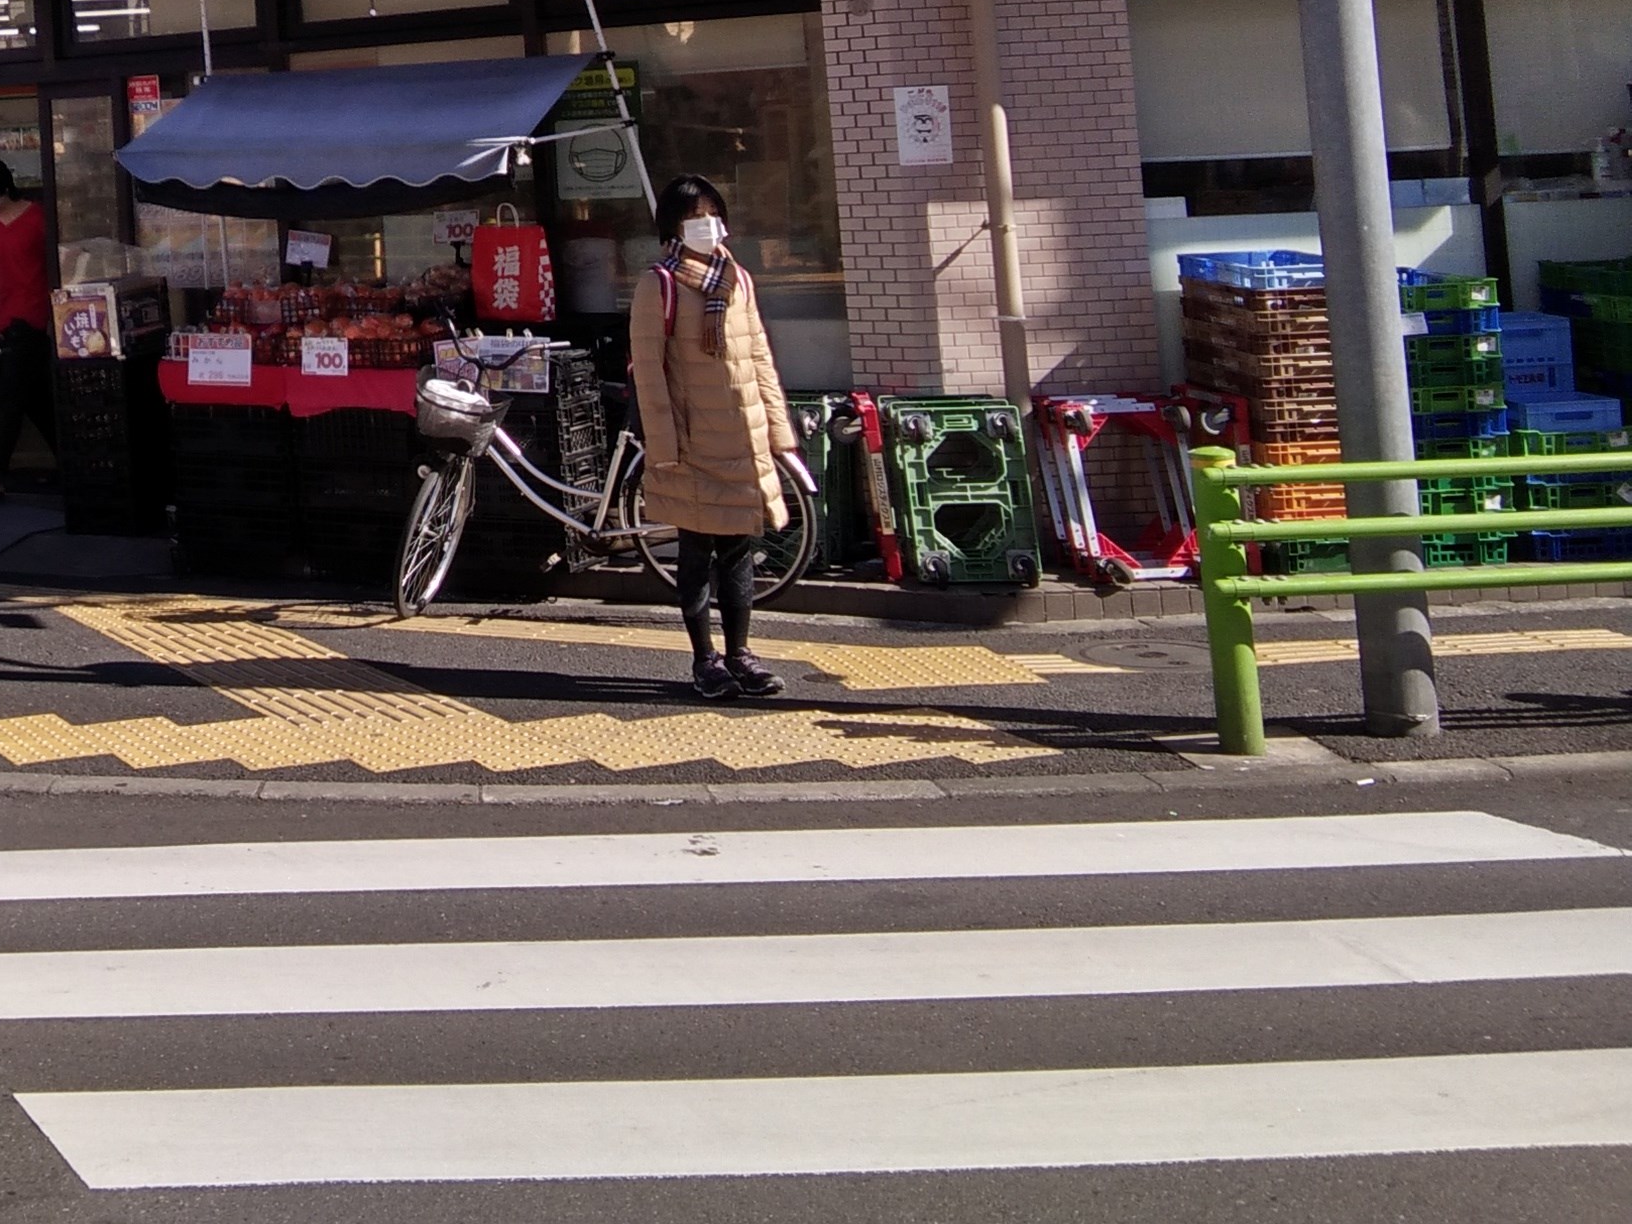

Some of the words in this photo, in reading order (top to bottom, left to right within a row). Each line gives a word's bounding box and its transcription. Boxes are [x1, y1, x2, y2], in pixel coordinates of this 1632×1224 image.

[446, 223, 474, 238] 100
[492, 245, 521, 310] 福袋
[315, 352, 343, 369] 100
